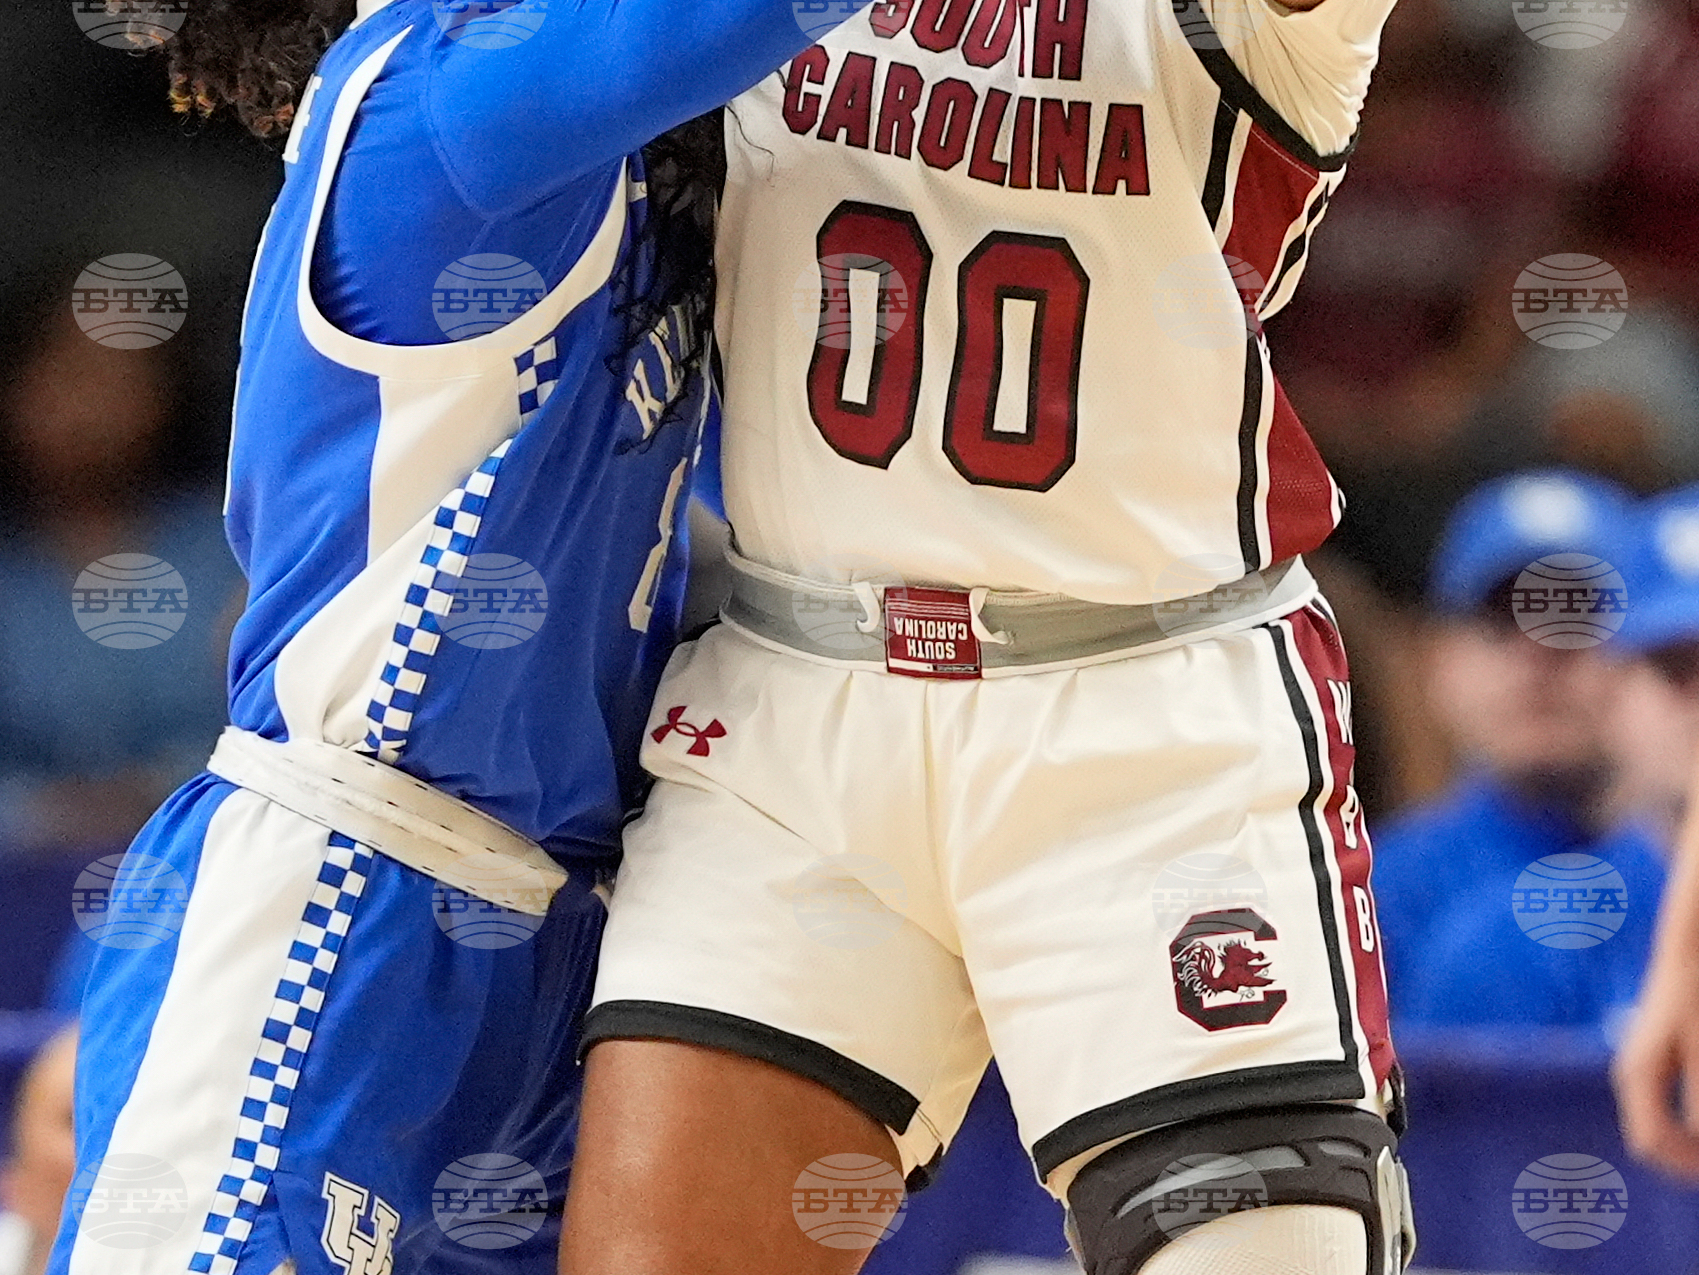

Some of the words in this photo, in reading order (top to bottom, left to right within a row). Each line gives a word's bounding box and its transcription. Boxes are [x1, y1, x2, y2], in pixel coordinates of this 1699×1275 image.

[782, 44, 1150, 195] CAROLINA
[806, 199, 1090, 493] 00
[893, 617, 968, 640] CAROLINA
[906, 638, 956, 660] SOUTH
